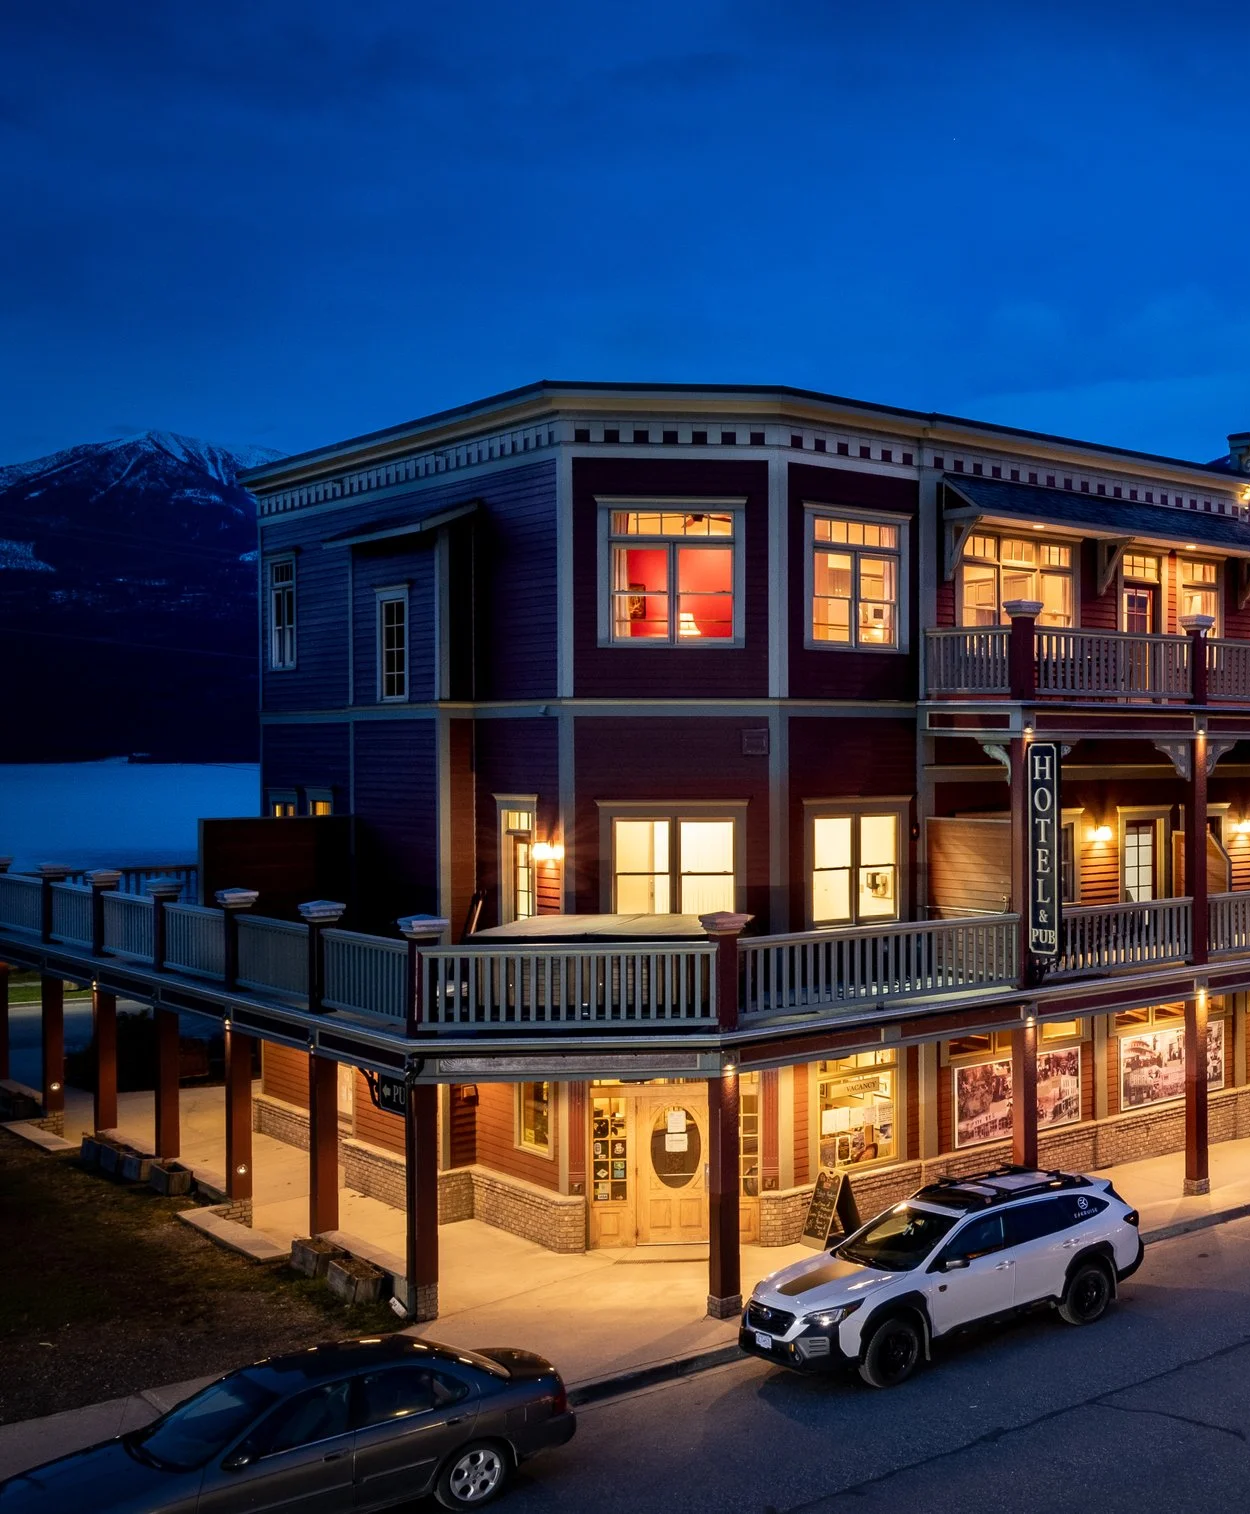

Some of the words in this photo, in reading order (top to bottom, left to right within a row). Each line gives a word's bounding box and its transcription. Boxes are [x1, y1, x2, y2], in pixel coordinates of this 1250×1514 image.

[1032, 755, 1052, 904] HOTEL
[1038, 909, 1049, 923] &
[1031, 928, 1056, 944] PUB
[846, 1080, 878, 1092] VACANCY
[392, 1084, 406, 1105] PU
